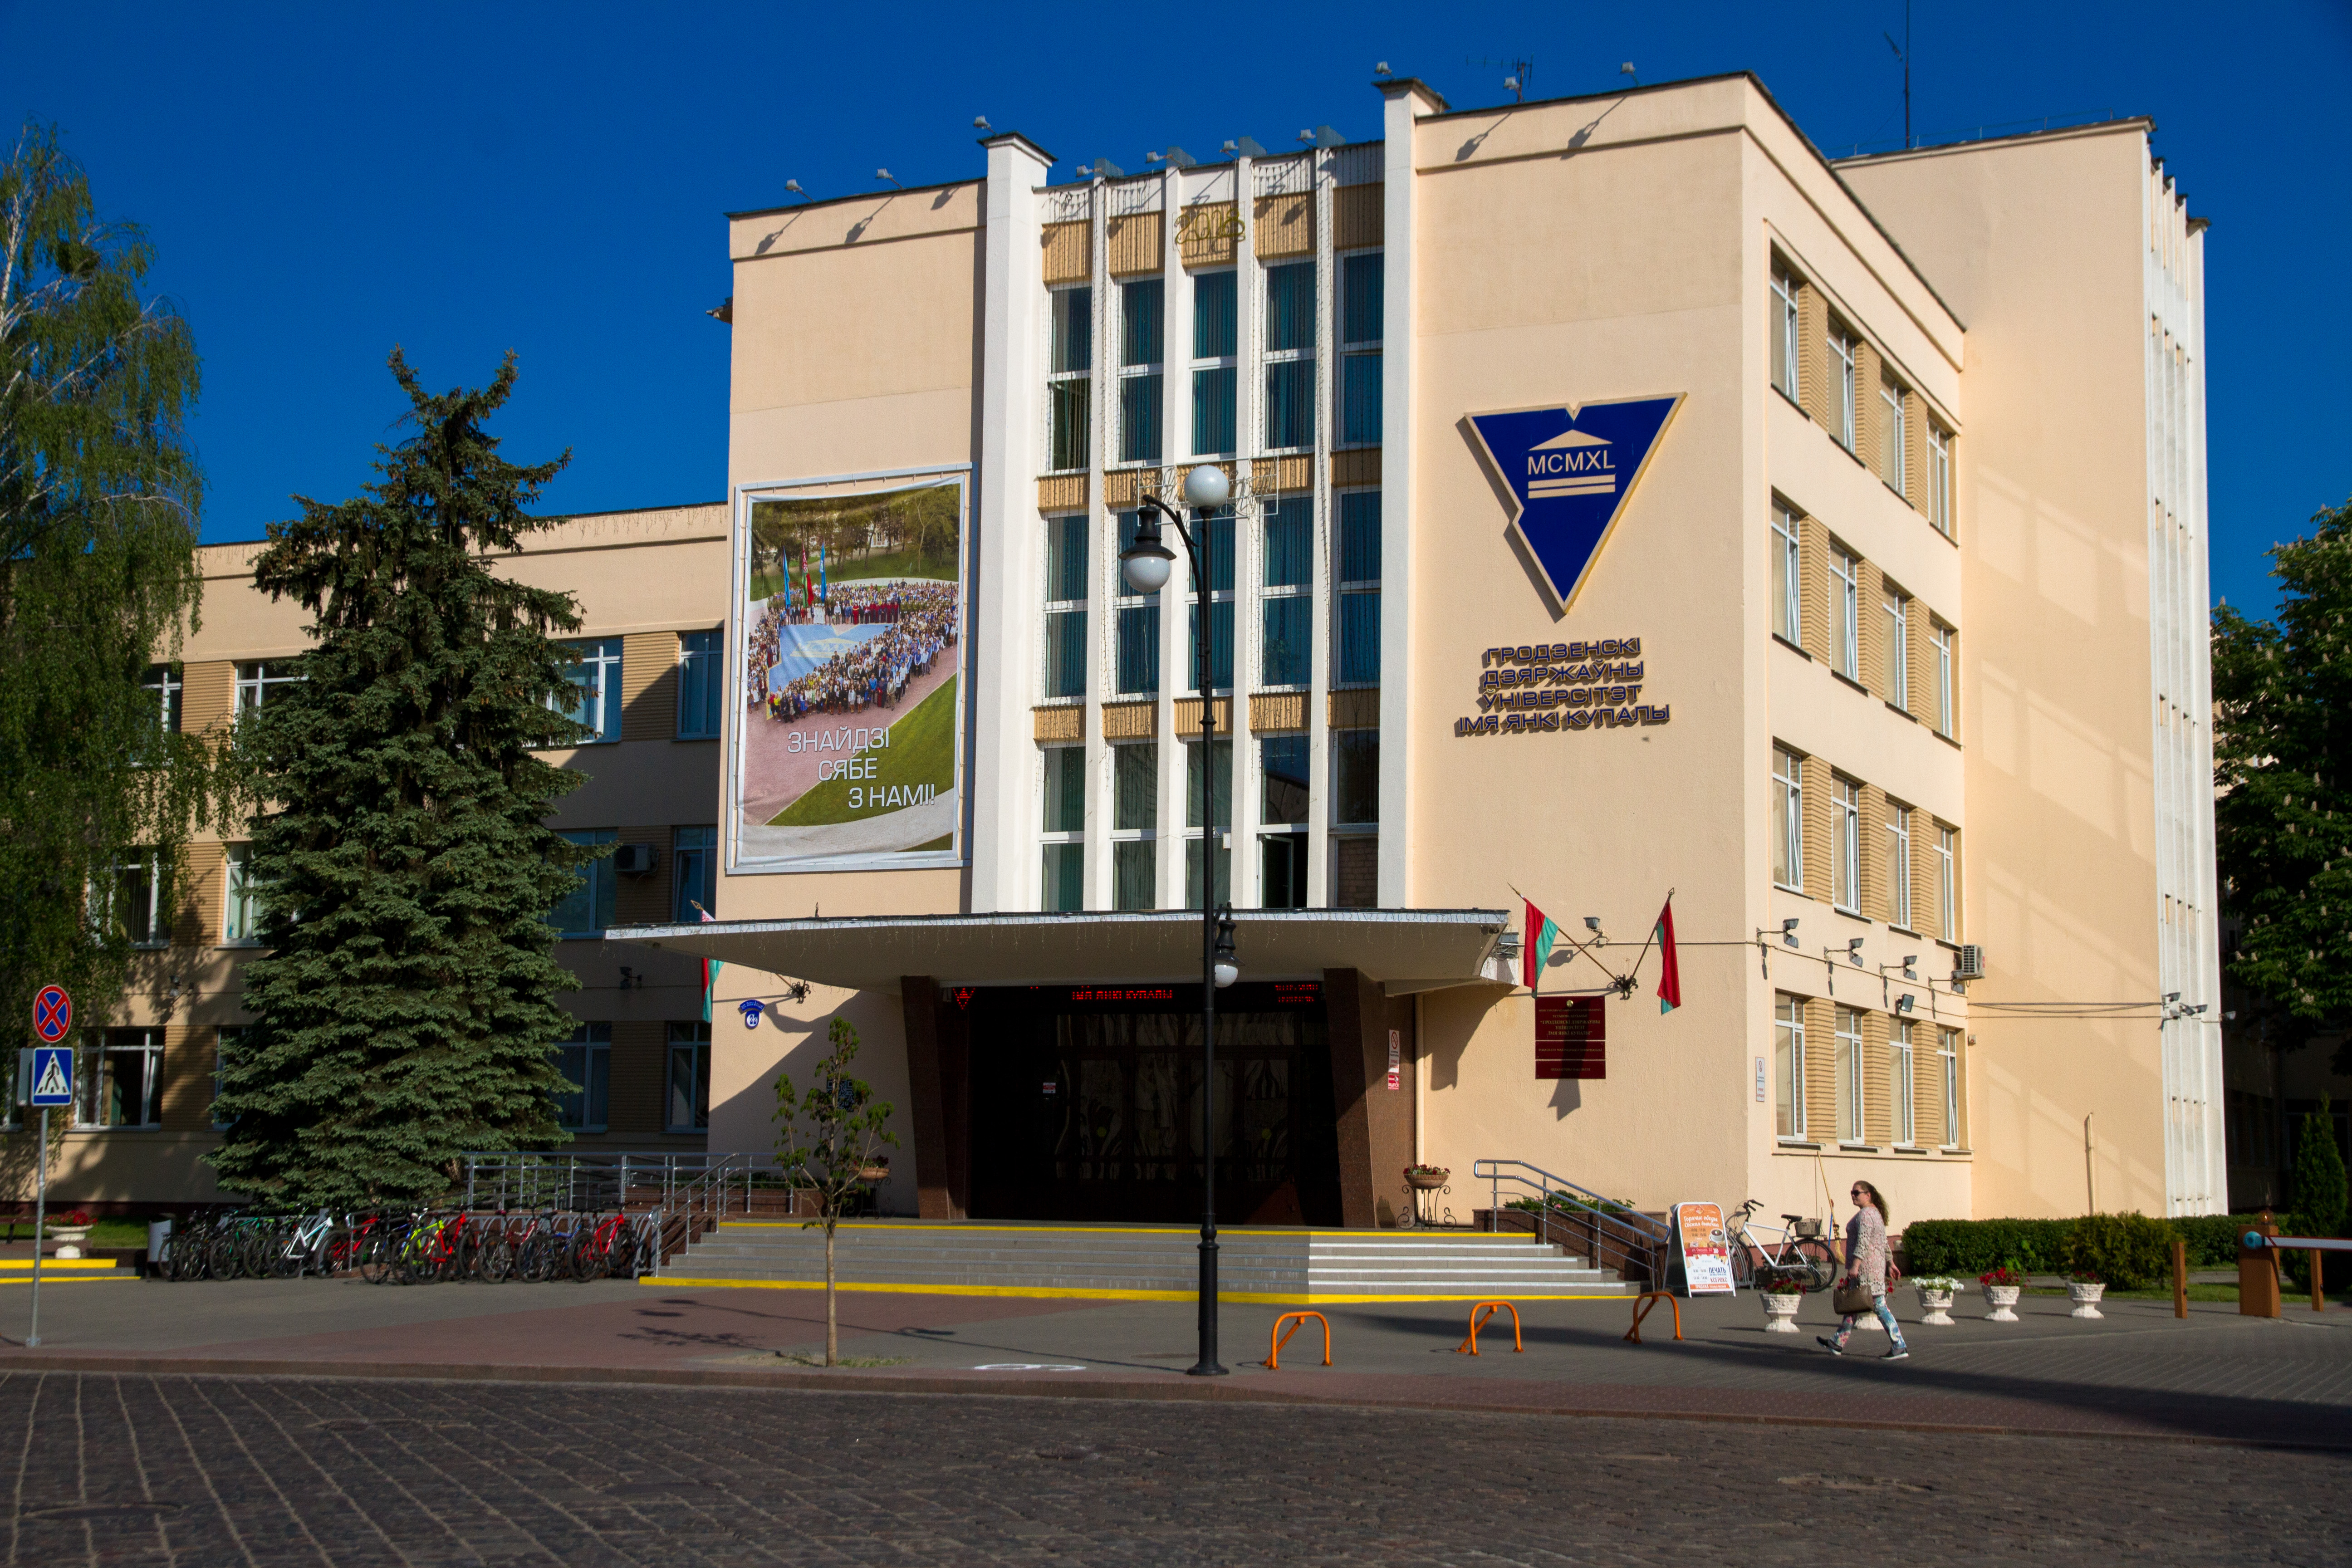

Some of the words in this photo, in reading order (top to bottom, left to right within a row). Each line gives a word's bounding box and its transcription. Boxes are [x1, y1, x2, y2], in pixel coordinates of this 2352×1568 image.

[1528, 450, 1616, 475] MCMXL
[1487, 637, 1641, 663] ГРОДЗЕНСКІ
[1483, 659, 1644, 688] ДЗЯРЖАЎНЫ
[1459, 715, 1499, 732] ІМЯ
[1506, 712, 1560, 729] ЯНКІ
[1566, 704, 1671, 726] КУПАЛЫ
[787, 726, 889, 754] ЗНАЙДЗІ
[818, 757, 877, 781] СЯБЕ
[848, 787, 863, 809] З
[869, 784, 935, 807] НАМІ!
[1073, 991, 1092, 1000] ІМЯ
[1097, 990, 1122, 999] ЯНКІ
[1126, 990, 1172, 999] КУПАЛЫ
